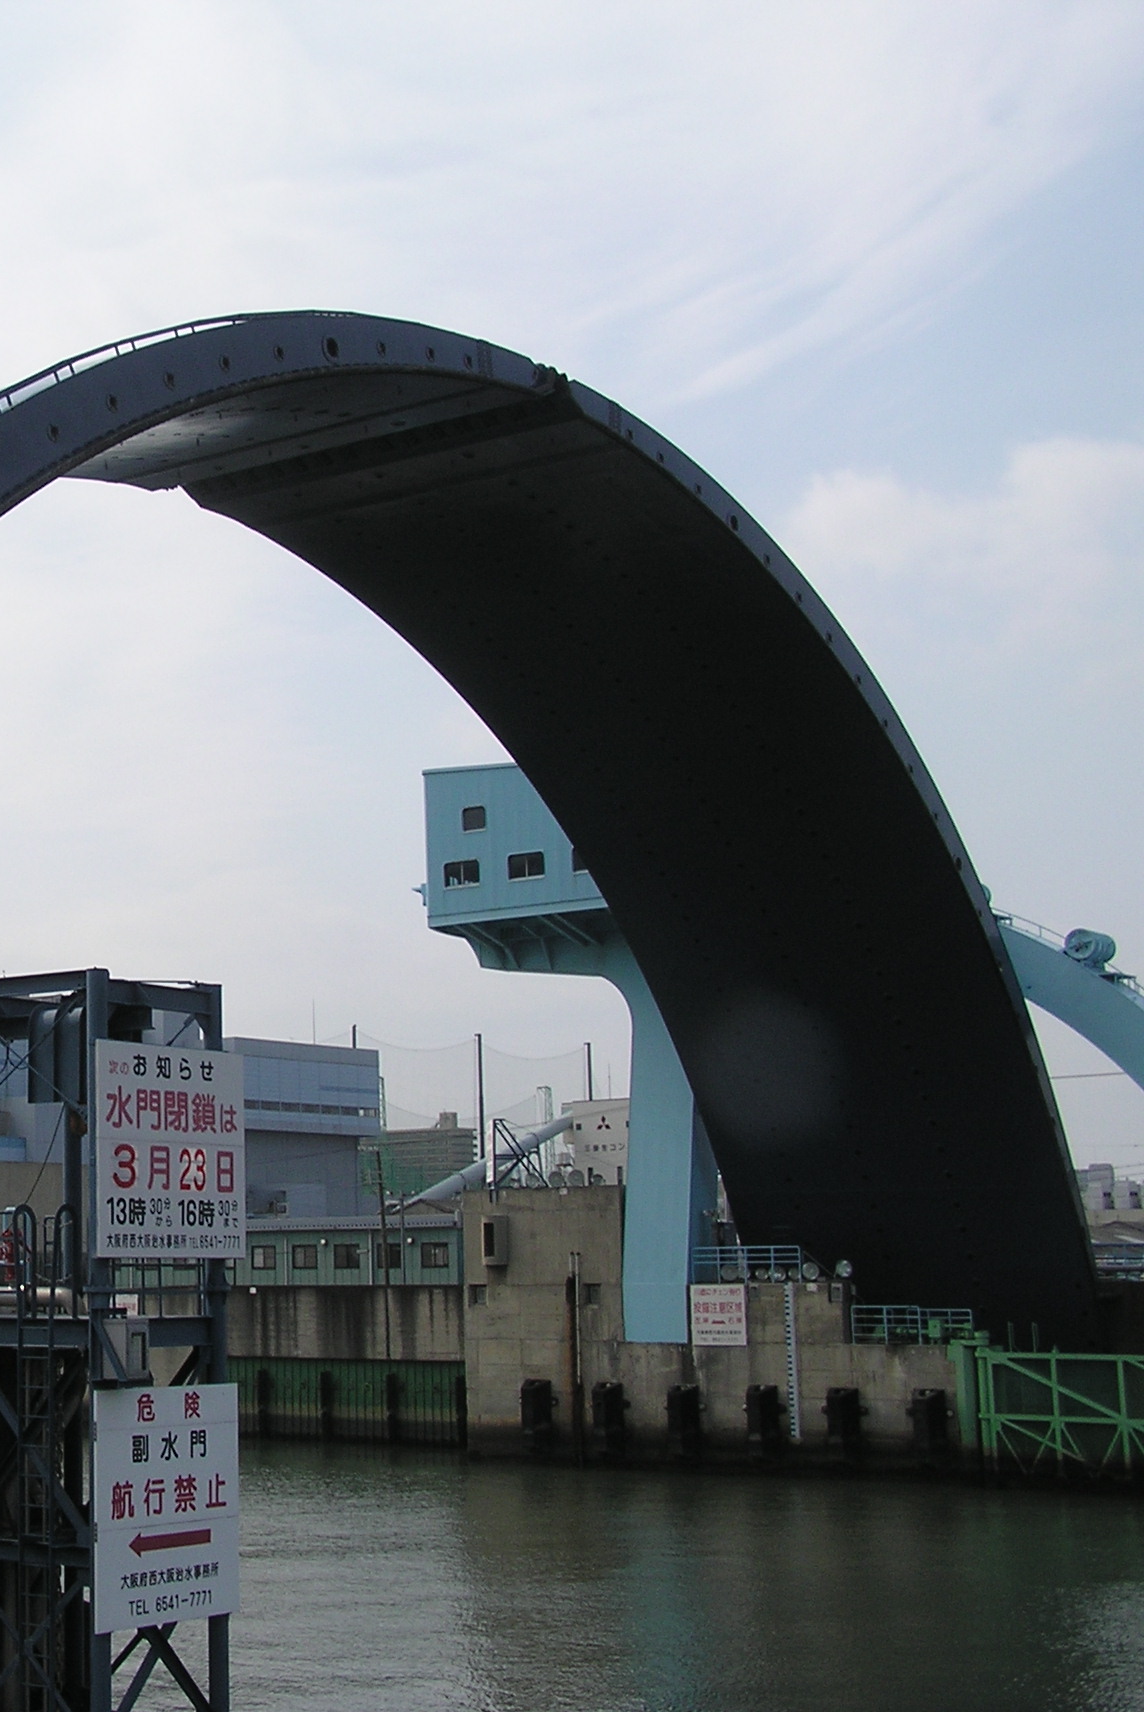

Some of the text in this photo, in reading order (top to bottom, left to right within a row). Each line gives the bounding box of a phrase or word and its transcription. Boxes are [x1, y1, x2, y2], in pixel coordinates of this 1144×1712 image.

[105, 1085, 238, 1134] 水門閉鎖は
[112, 1143, 234, 1193] 3月23日
[199, 1235, 240, 1249] 6541-7771
[136, 1391, 201, 1422] 危険
[131, 1429, 207, 1463] 副水門
[111, 1473, 227, 1520] 航行禁止
[120, 1562, 219, 1590] 大阪府西大阪治水事務所
[128, 1589, 213, 1616] TEL 6541-7771
